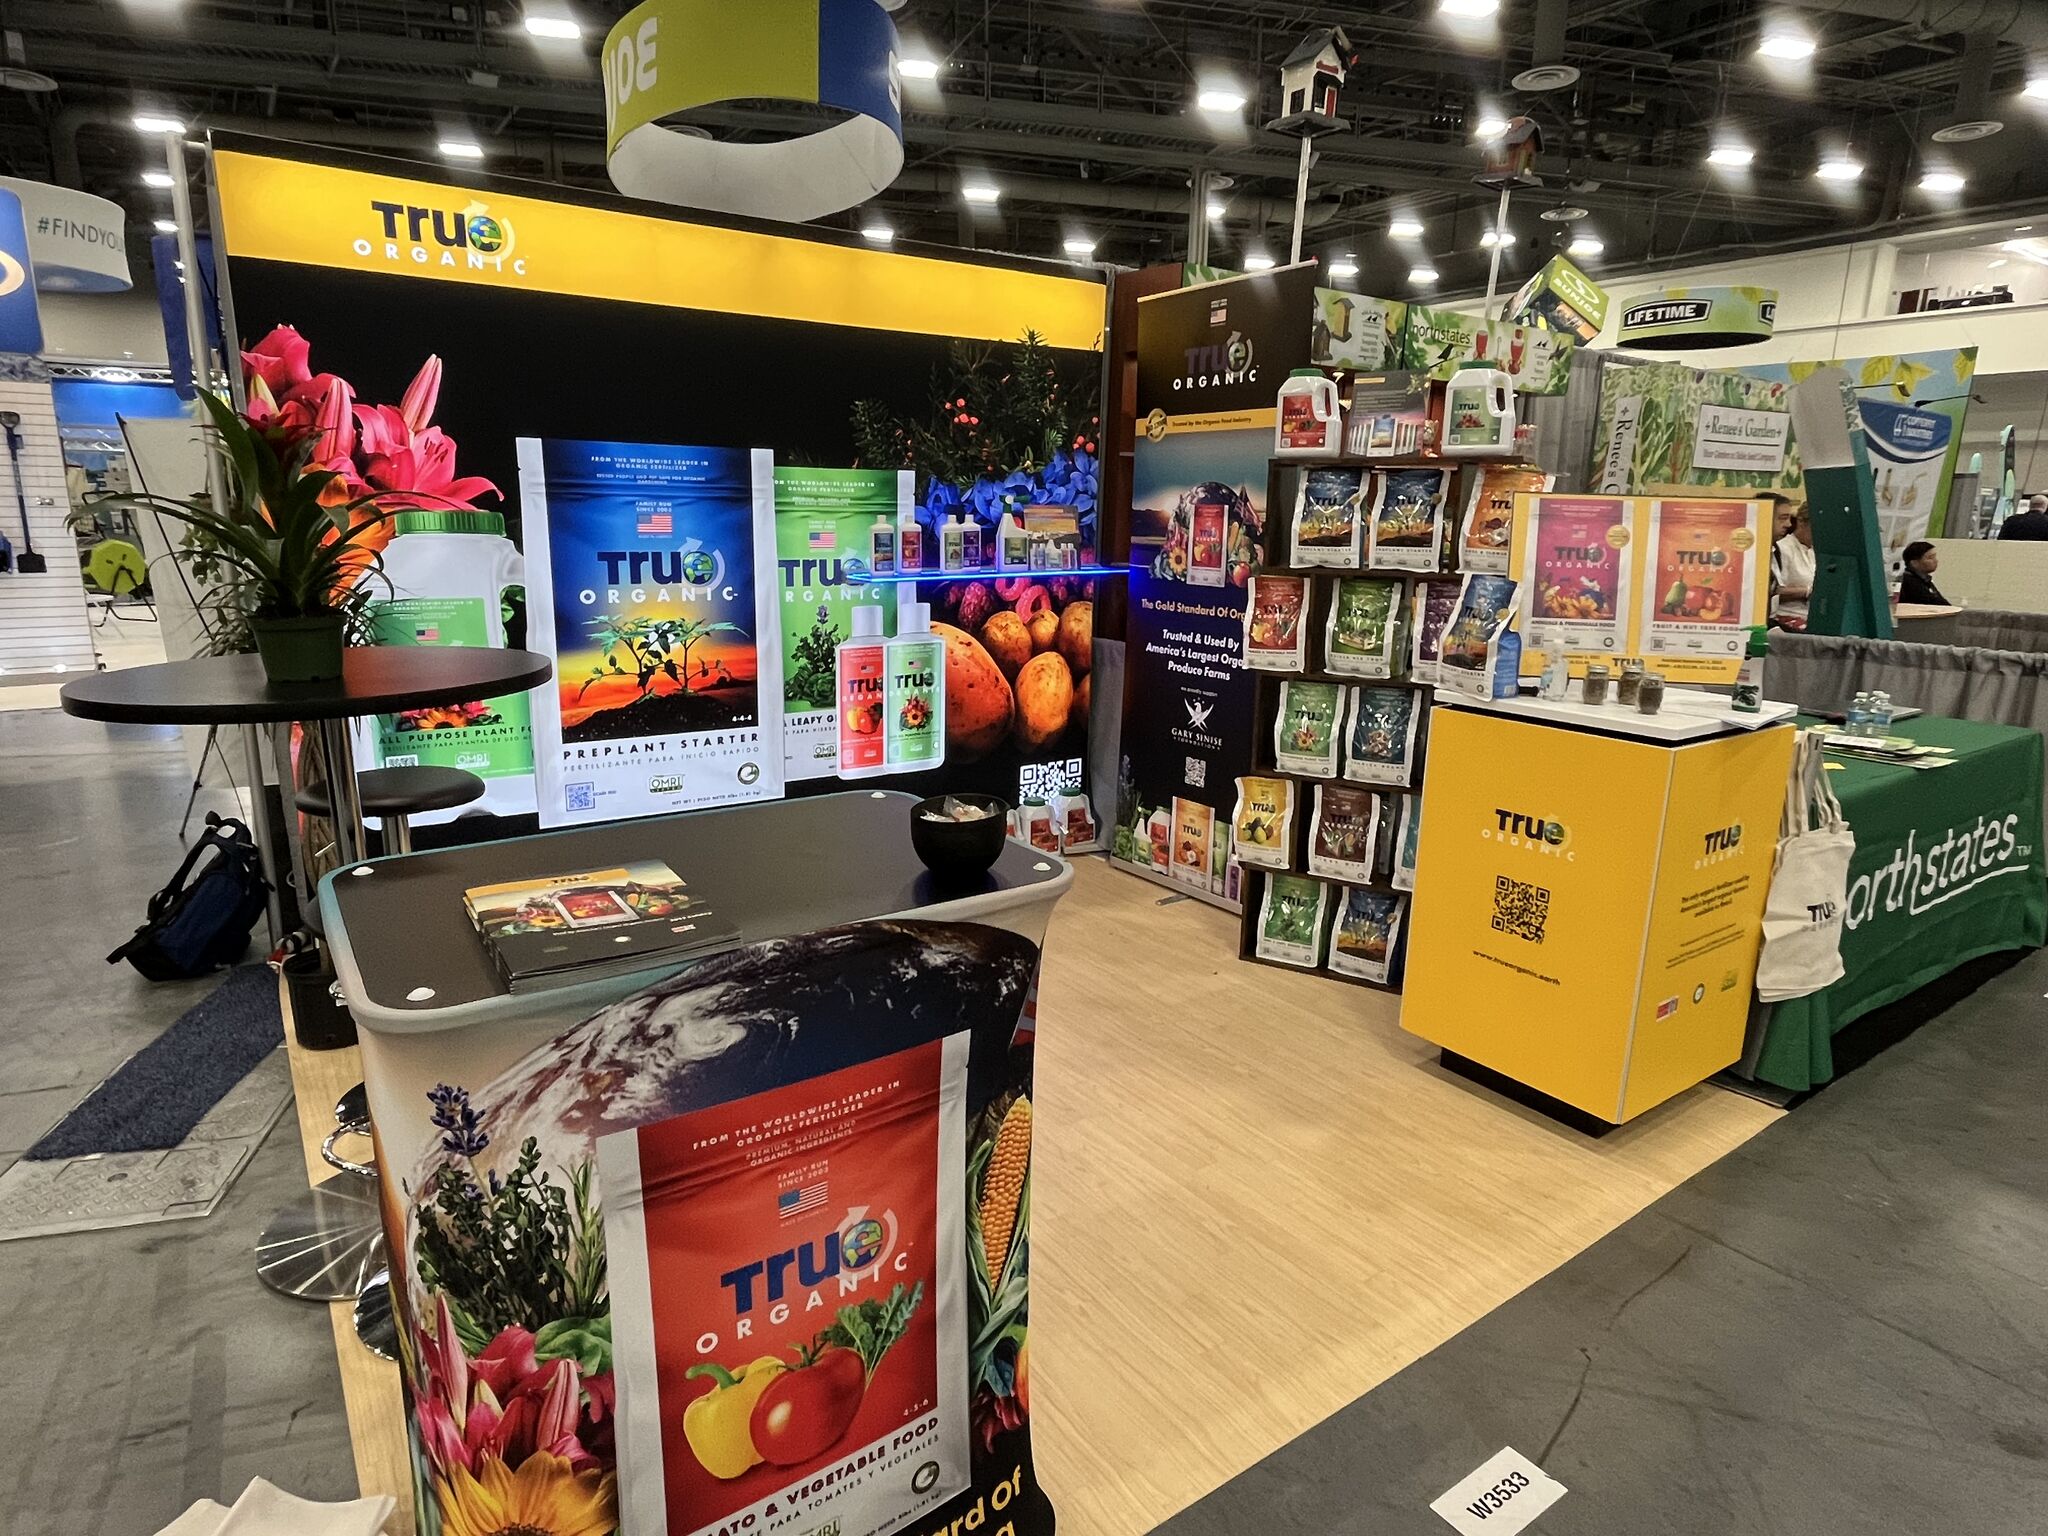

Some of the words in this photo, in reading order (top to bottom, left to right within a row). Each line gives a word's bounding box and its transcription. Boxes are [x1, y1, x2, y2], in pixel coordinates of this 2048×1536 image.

[353, 239, 526, 275] ORGANIC
[1627, 304, 1696, 325] LIFETIME
[1412, 323, 1471, 343] northstates
[1173, 369, 1257, 390] ORGANIC
[1607, 418, 1633, 478] Renee's
[1545, 561, 1610, 570] ORGANIC
[1667, 565, 1734, 574] ORGANIC
[579, 586, 734, 605] ORGANIC
[785, 588, 880, 602] RGANIC
[1141, 598, 1154, 610] The
[1155, 600, 1175, 612] Gold
[1176, 602, 1216, 617] Standard
[1217, 606, 1228, 618] Of
[1162, 629, 1194, 643] Trusted
[1194, 634, 1202, 644] &
[1204, 635, 1226, 648] Used
[1228, 638, 1240, 652] By
[1145, 642, 1187, 658] America's
[1188, 649, 1219, 665] Largest
[1167, 660, 1203, 676] Produce
[1204, 667, 1231, 681] Farms
[732, 714, 752, 722] 4-4-4
[791, 714, 825, 727] LEAFY
[379, 736, 401, 745] ALL
[409, 730, 468, 742] PURPOSE
[475, 727, 514, 737] PLANT
[563, 741, 666, 761] PREPLANT
[681, 733, 759, 749] STARTER
[1171, 727, 1193, 739] GARY
[1195, 733, 1223, 746] SINISE
[564, 758, 642, 772] FERTILIZANTE
[648, 755, 674, 764] PARA
[681, 751, 716, 760] INICIO
[651, 776, 681, 788] OMRI
[1481, 828, 1575, 862] ORGANIC
[1846, 814, 2018, 930] orthstates
[692, 1133, 729, 1151] FROM
[735, 1124, 757, 1138] THE
[762, 1100, 837, 1130] WORLDWIDE
[842, 1086, 883, 1105] LEADER
[888, 1080, 900, 1091] IN
[736, 1124, 794, 1147] ORGANIC
[799, 1102, 864, 1128] FERTILIZER
[795, 1128, 834, 1145] NATURAL
[836, 1119, 857, 1131] AND
[750, 1149, 793, 1167] ORGANIC
[795, 1128, 853, 1152] INGREDIENTS
[777, 1166, 808, 1182] FAMILY
[810, 1159, 829, 1171] RUN
[778, 1175, 804, 1189] SINCE
[808, 1166, 829, 1179] 2003
[695, 1252, 908, 1355] ORGANIC
[706, 1514, 757, 1536] ATO
[765, 1503, 779, 1517] &
[786, 1445, 886, 1505] VEGETABLE
[893, 1417, 939, 1450] FOOD
[770, 1510, 801, 1531] PARA
[808, 1477, 863, 1511] TOMATES
[868, 1470, 875, 1480] Y
[880, 1434, 940, 1472] VEGETALES
[991, 1464, 1021, 1511] Of
[1466, 1471, 1530, 1520] W3533
